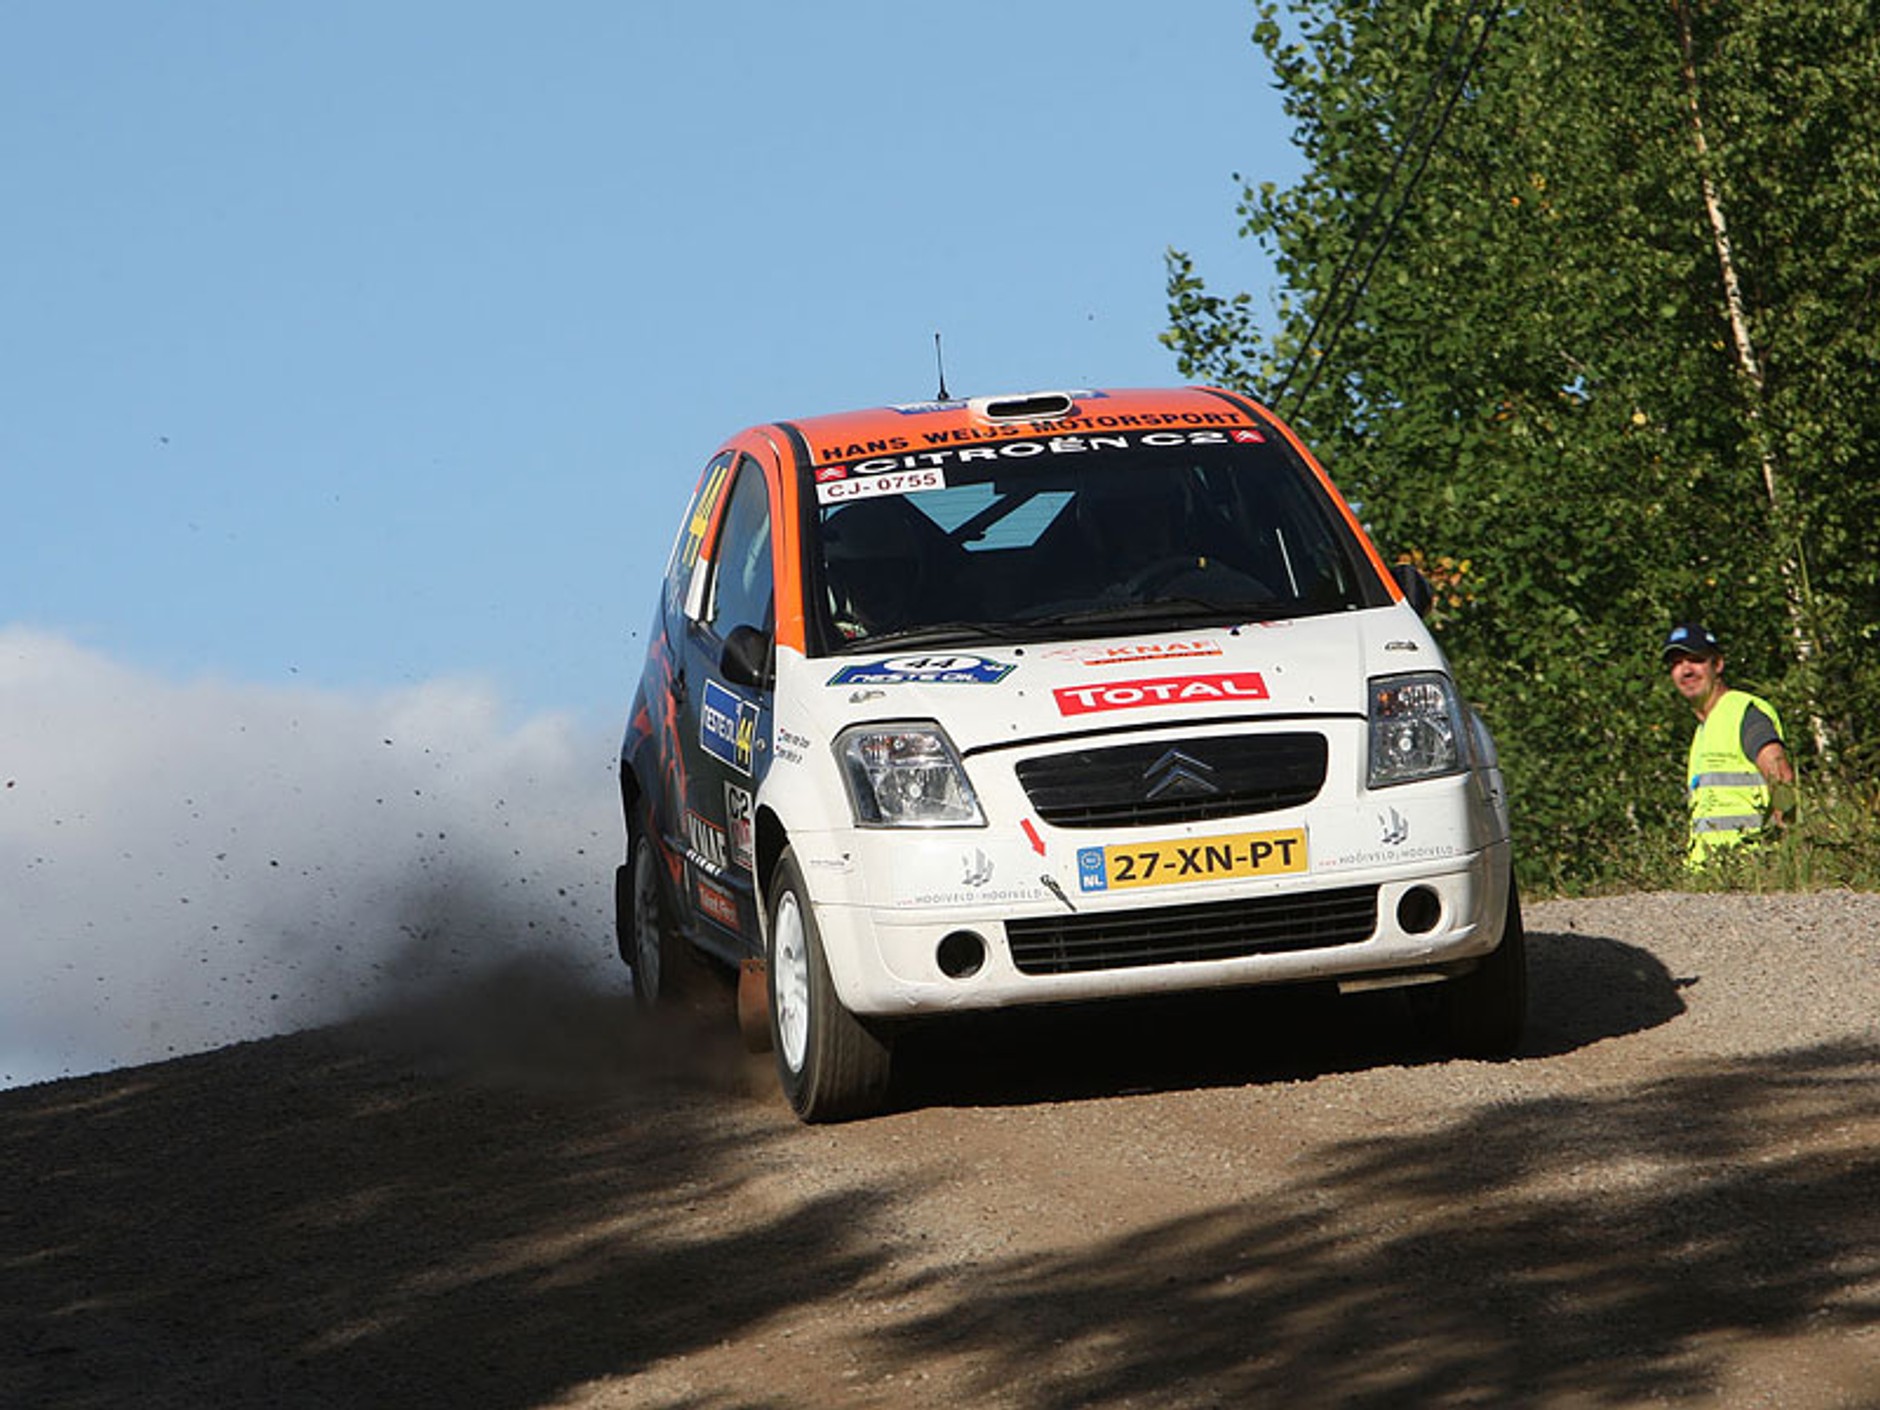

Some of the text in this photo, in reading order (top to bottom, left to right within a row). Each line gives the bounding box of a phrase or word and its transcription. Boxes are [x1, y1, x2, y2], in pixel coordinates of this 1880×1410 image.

[822, 413, 1241, 460] HANS WEIJS MOTORSPORT
[853, 431, 1228, 474] CITROËN C2
[903, 657, 957, 669] 44
[1106, 640, 1212, 657] KNAF
[1063, 680, 1258, 708] TOTAL
[737, 717, 753, 765] 44
[1113, 838, 1298, 882] 27-XN-PT
[1083, 874, 1104, 888] NL
